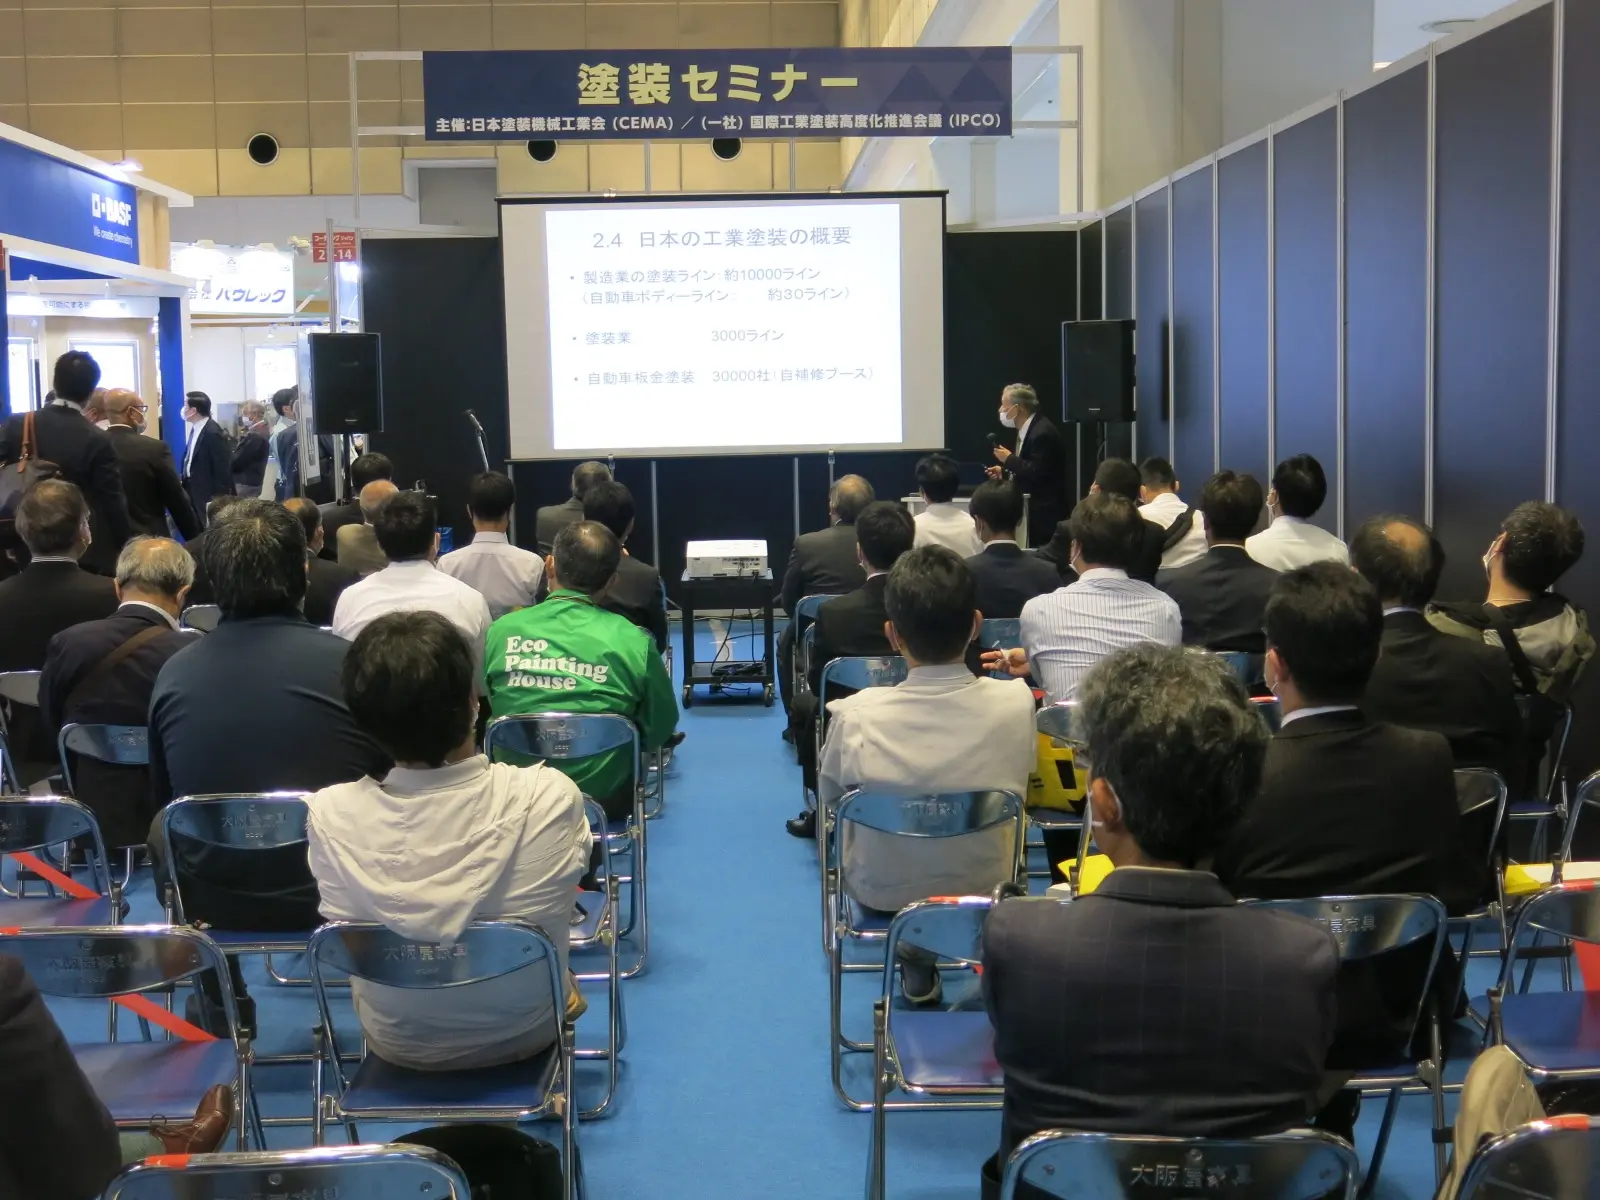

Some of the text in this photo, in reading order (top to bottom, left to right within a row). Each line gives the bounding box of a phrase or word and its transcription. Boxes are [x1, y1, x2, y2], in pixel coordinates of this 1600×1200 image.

[577, 62, 859, 105] 塗装セミナー
[612, 116, 674, 131] (CEMA)
[701, 115, 743, 131] (一社)
[749, 113, 943, 130] 国際工業塗装高度化推進会議
[949, 113, 1001, 129] (IPCO)
[106, 196, 132, 227] BASF
[592, 226, 852, 248] 2.4 日本の工業塗装の概要
[318, 249, 353, 260] 2-14
[586, 329, 784, 345] 塗装業 3000ライン
[588, 370, 695, 385] 自動車板金塗装
[506, 636, 549, 653] Eco
[505, 654, 609, 683] Painting
[507, 671, 577, 690] House
